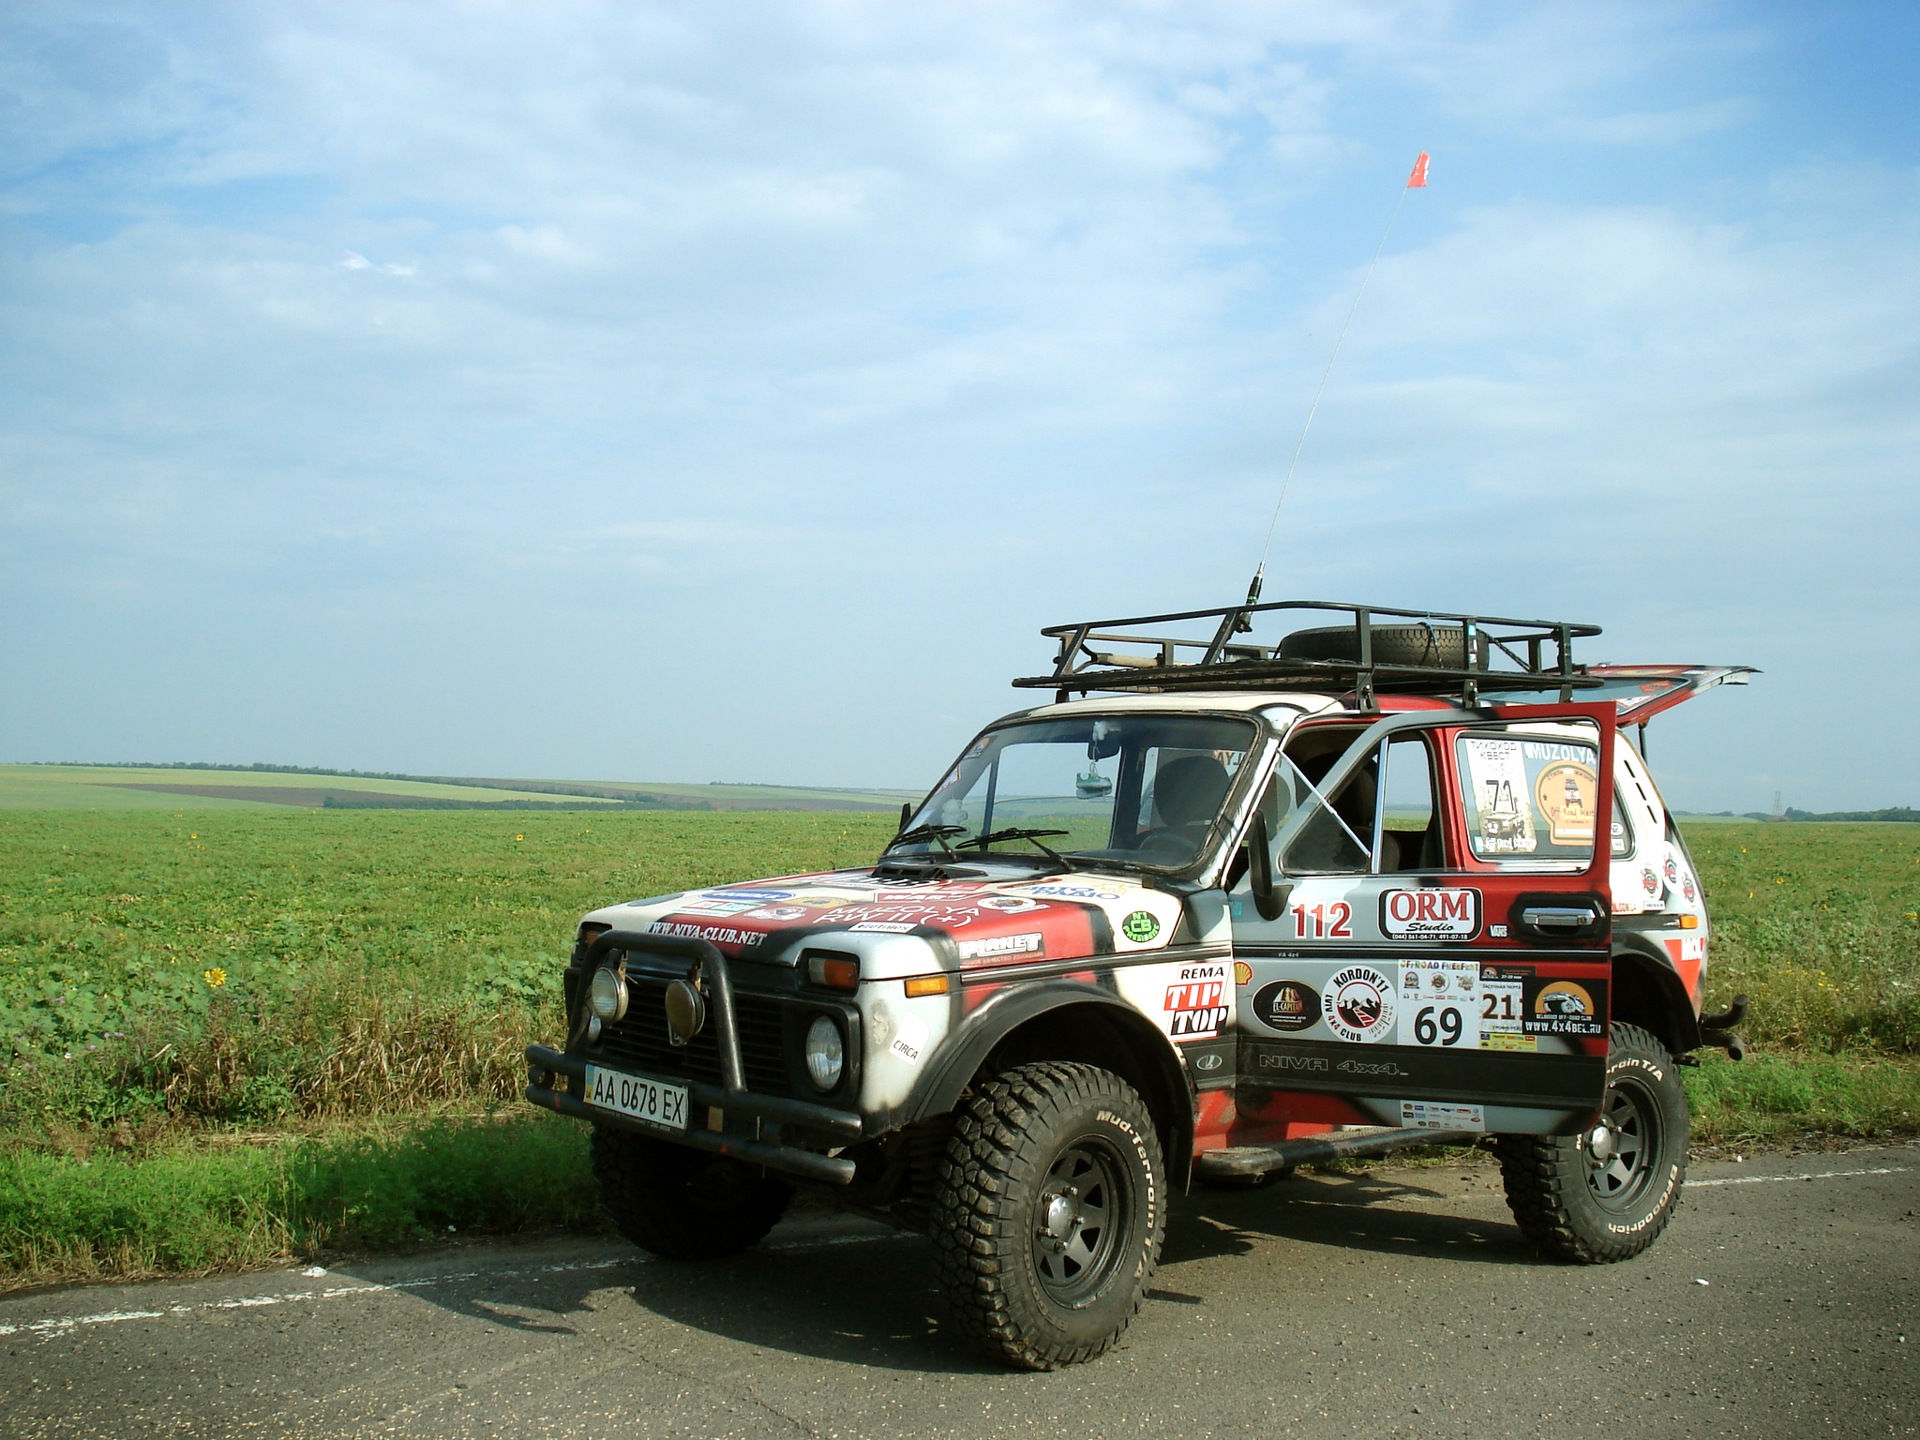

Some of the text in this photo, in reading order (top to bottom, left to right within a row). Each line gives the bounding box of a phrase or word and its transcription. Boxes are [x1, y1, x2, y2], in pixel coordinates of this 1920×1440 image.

[1471, 741, 1517, 750] ТИХОХОД
[1480, 752, 1509, 760] КВЕСТ
[1486, 780, 1515, 811] 71
[829, 906, 979, 916] MUZOLYA
[1390, 893, 1470, 921] ORM
[813, 913, 884, 924] RW
[919, 914, 972, 927] (+)
[1130, 919, 1152, 933] CB
[1292, 902, 1351, 937] 112
[1405, 922, 1455, 931] Studio
[645, 922, 768, 948] WWW.NIVA-CLUB.NET
[1392, 933, 1407, 941] (044)
[1490, 925, 1508, 937] VANS
[959, 932, 1044, 959] PLANET
[1181, 966, 1224, 980] REMA
[1333, 968, 1390, 992] KORDON'11
[1167, 982, 1222, 1010] TIP
[1482, 994, 1524, 1020] 21
[1174, 1007, 1227, 1034] TOP
[1328, 1015, 1341, 1030] 4x4
[1415, 1006, 1463, 1046] 69
[1340, 1028, 1362, 1042] CLUB
[893, 1040, 918, 1060] CIRCA
[1259, 1054, 1328, 1071] NIVA
[1641, 1060, 1663, 1081] T/A
[593, 1072, 615, 1106] AA
[620, 1080, 658, 1115] 0678
[662, 1089, 684, 1124] EX
[1096, 1109, 1155, 1229] Mud-Terrain
[1608, 1164, 1678, 1234] BFGoodrich
